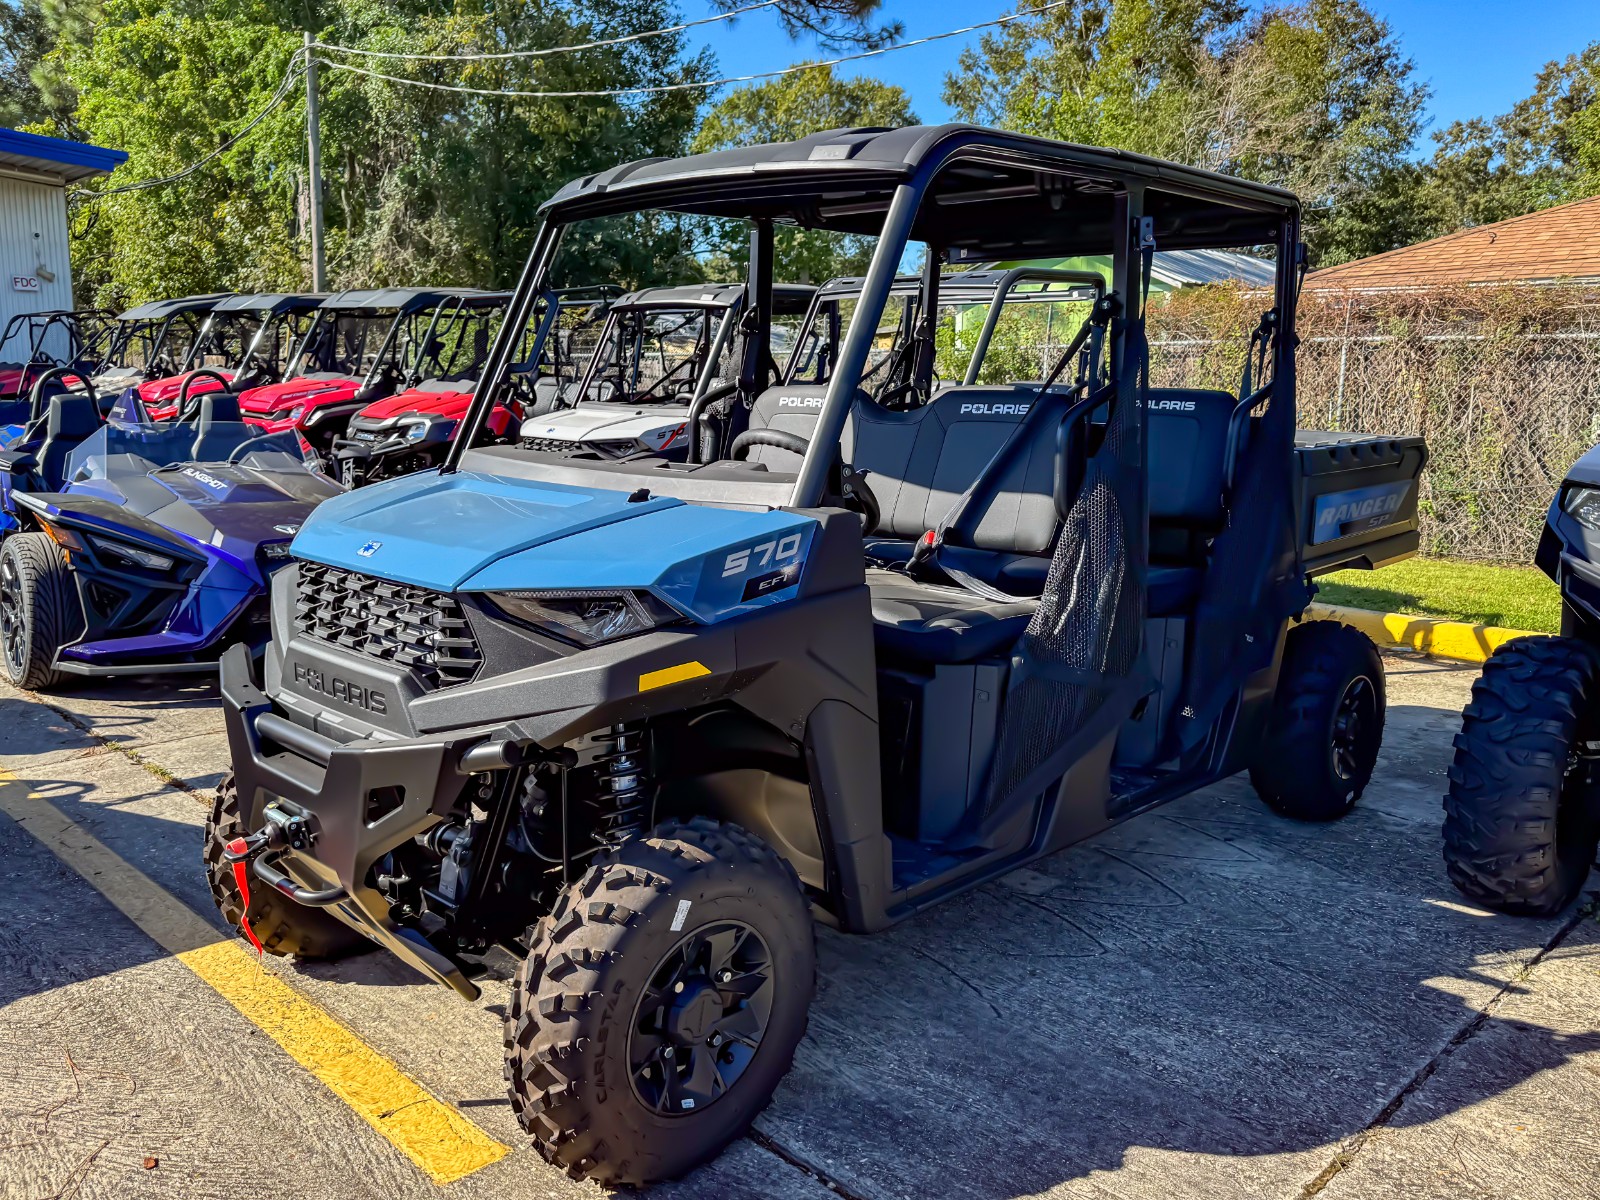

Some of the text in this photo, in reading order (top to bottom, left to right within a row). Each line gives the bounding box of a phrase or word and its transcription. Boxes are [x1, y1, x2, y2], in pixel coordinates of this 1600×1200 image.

[13, 277, 38, 288] FDC
[778, 396, 825, 407] POLAR
[1135, 399, 1196, 411] LARIS
[960, 403, 1030, 414] POLARIS
[1319, 494, 1398, 526] RANGER
[1367, 514, 1390, 527] SP
[721, 532, 802, 578] 570
[758, 574, 788, 590] EFI
[294, 661, 388, 717] POLARIS
